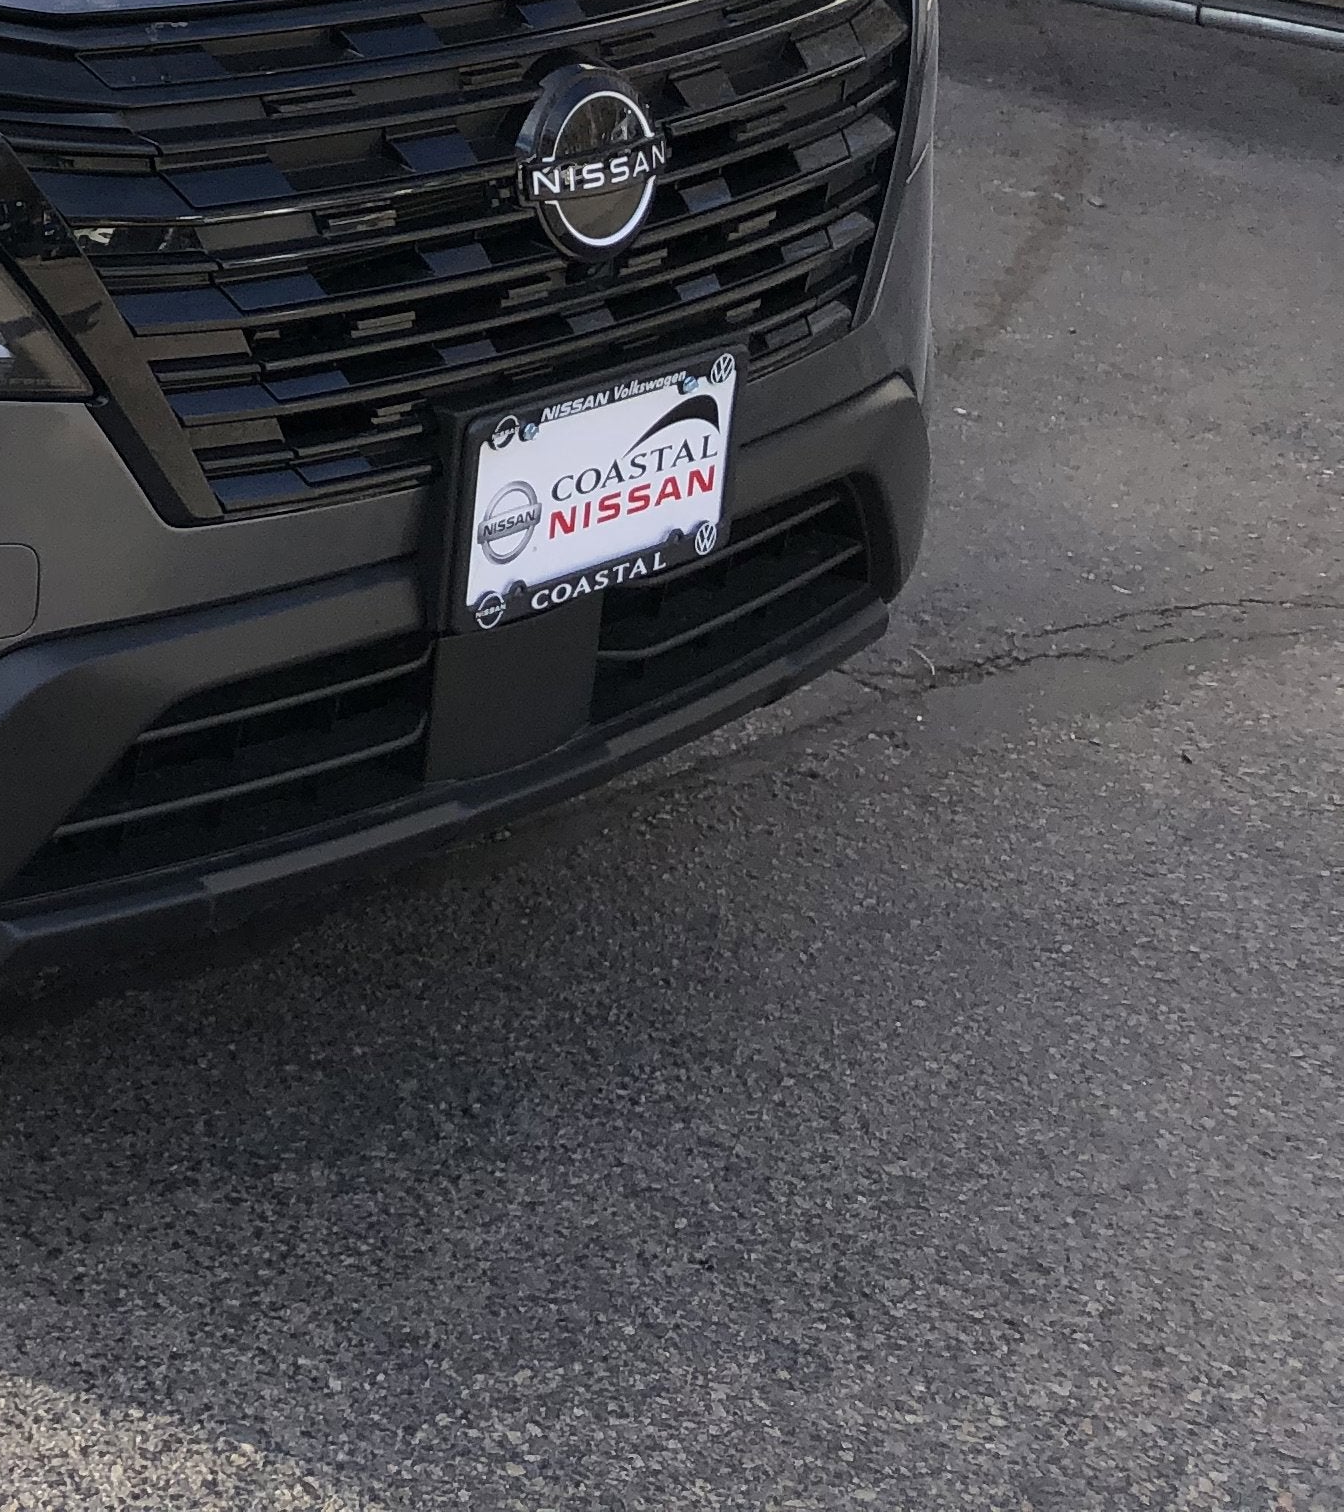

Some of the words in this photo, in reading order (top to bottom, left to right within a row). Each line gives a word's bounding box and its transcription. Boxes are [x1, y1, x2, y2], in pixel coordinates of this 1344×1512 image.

[531, 140, 666, 196] NISSAN
[540, 390, 610, 423] NISSAN
[613, 370, 688, 402] Volkswagen
[550, 435, 719, 502] COASTAL
[482, 508, 536, 538] NISSAN
[548, 464, 716, 540] NISSAN
[530, 552, 667, 611] COASTAL
